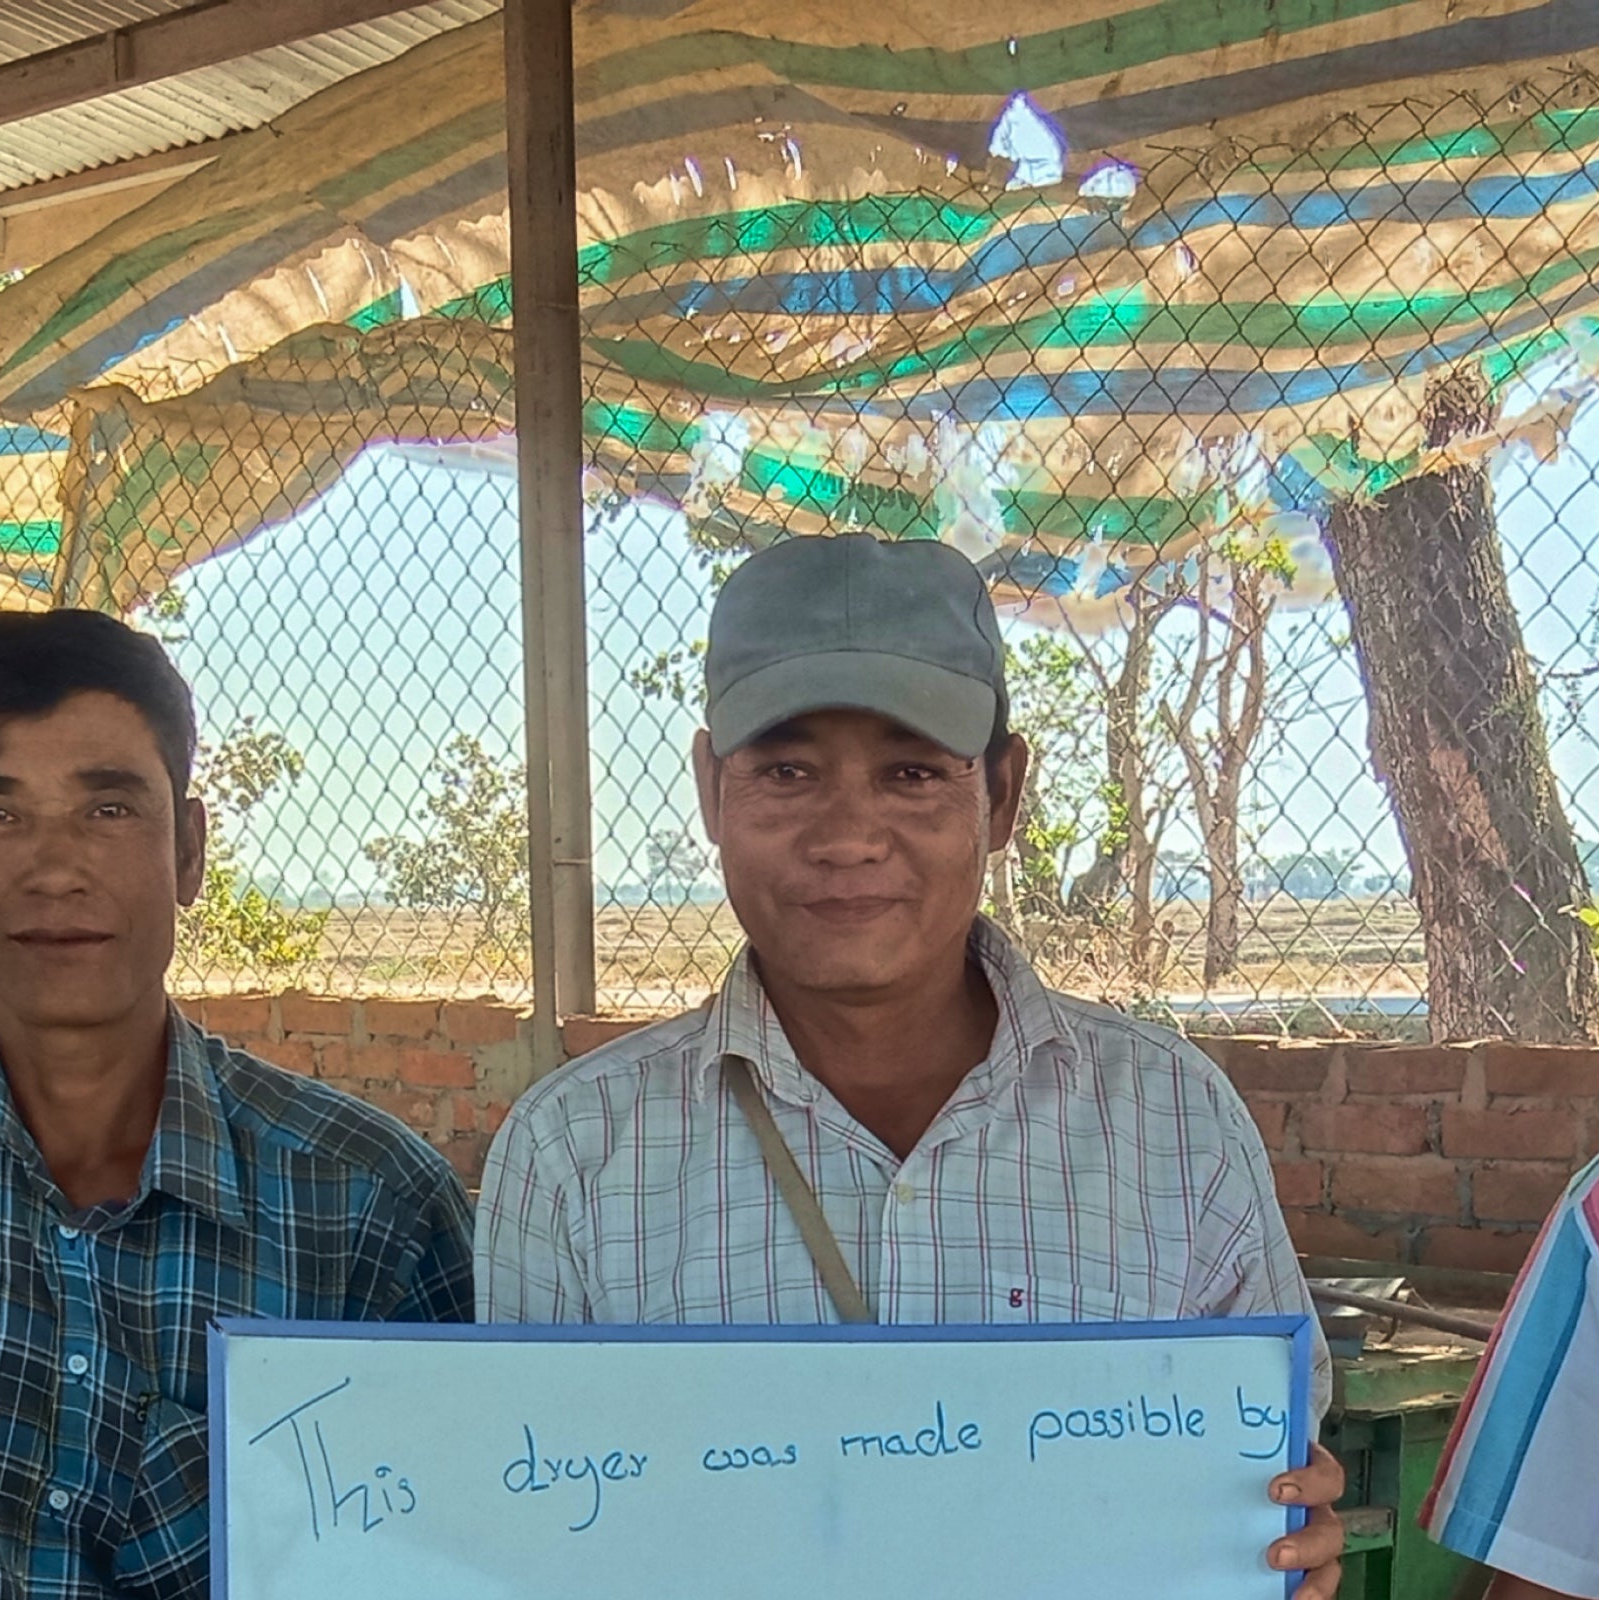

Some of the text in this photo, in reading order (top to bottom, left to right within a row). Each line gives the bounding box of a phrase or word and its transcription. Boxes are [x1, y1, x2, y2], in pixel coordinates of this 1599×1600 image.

[249, 1377, 1287, 1541] This dryer was made possible by
